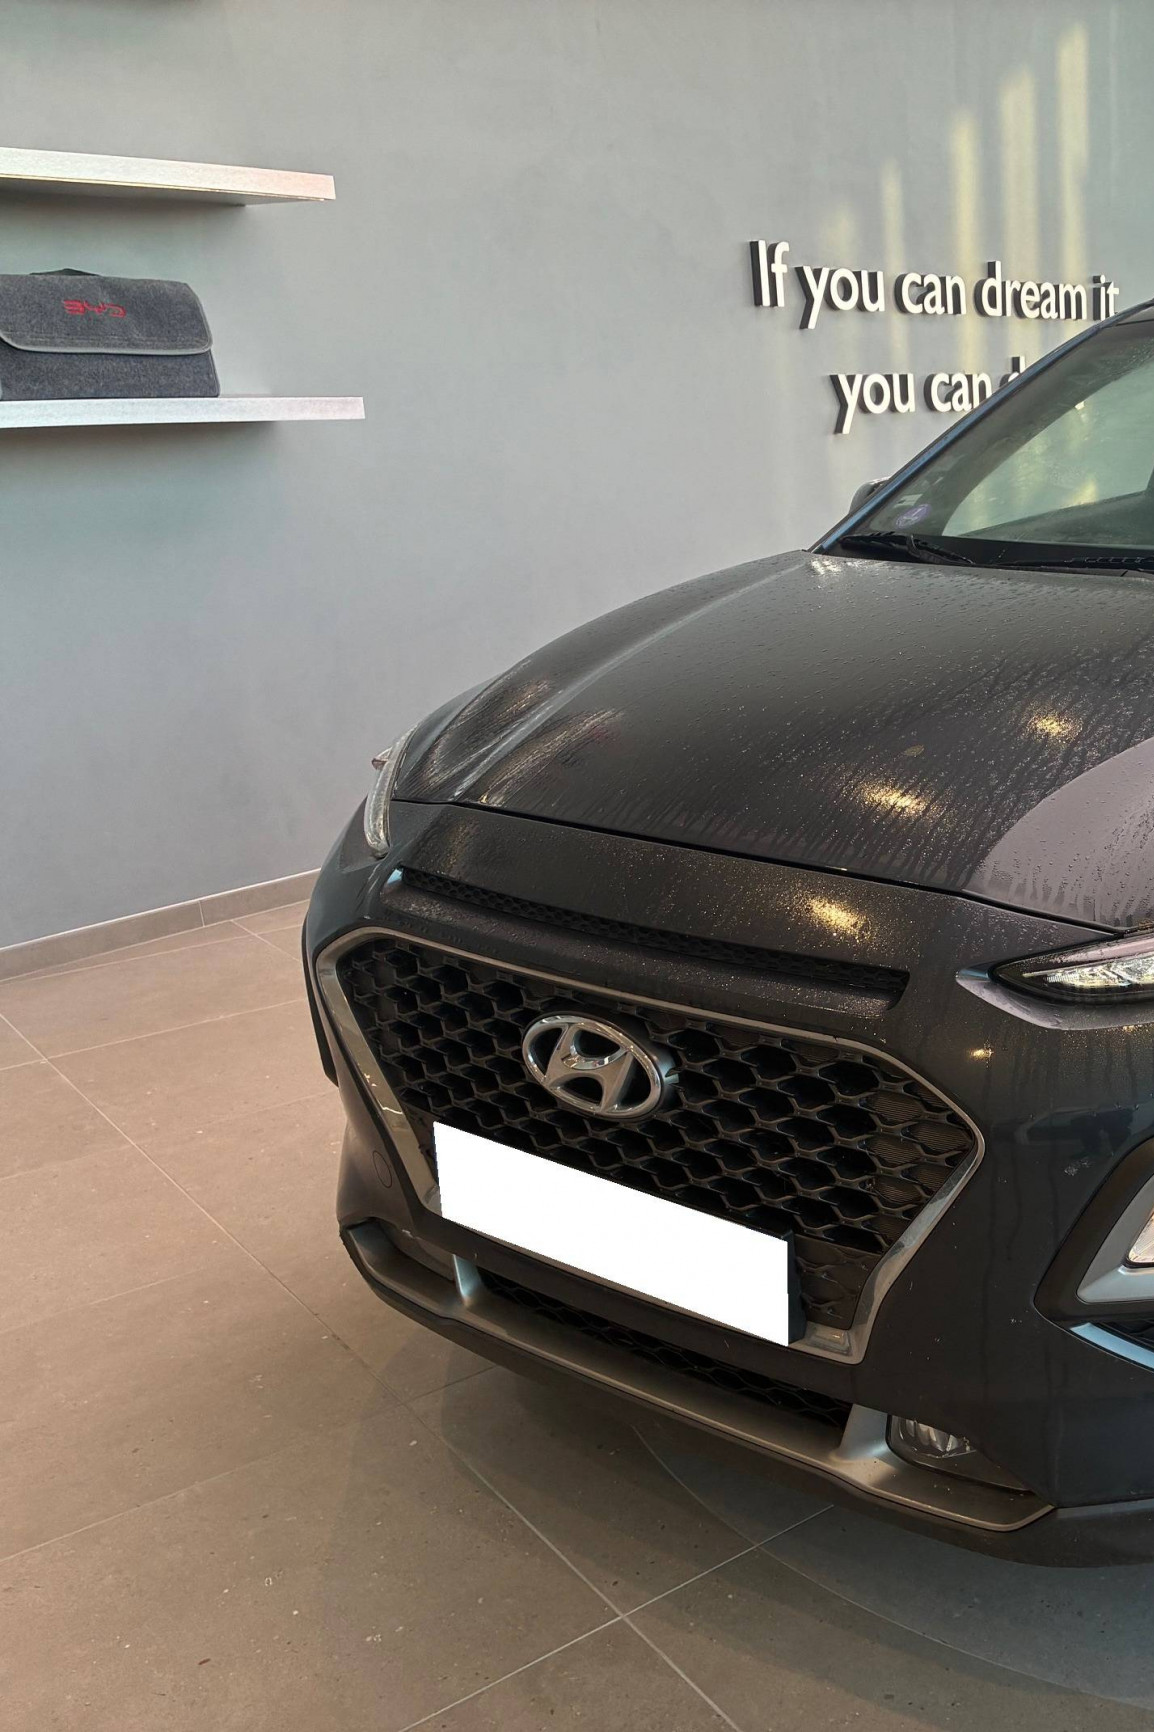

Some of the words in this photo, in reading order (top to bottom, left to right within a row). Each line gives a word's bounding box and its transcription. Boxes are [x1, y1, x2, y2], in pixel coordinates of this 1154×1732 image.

[749, 239, 790, 307] If
[796, 265, 886, 330] you
[895, 271, 967, 315] can
[974, 260, 1088, 320] dream
[1092, 274, 1120, 321] it
[830, 372, 916, 435] you
[923, 371, 993, 413] can
